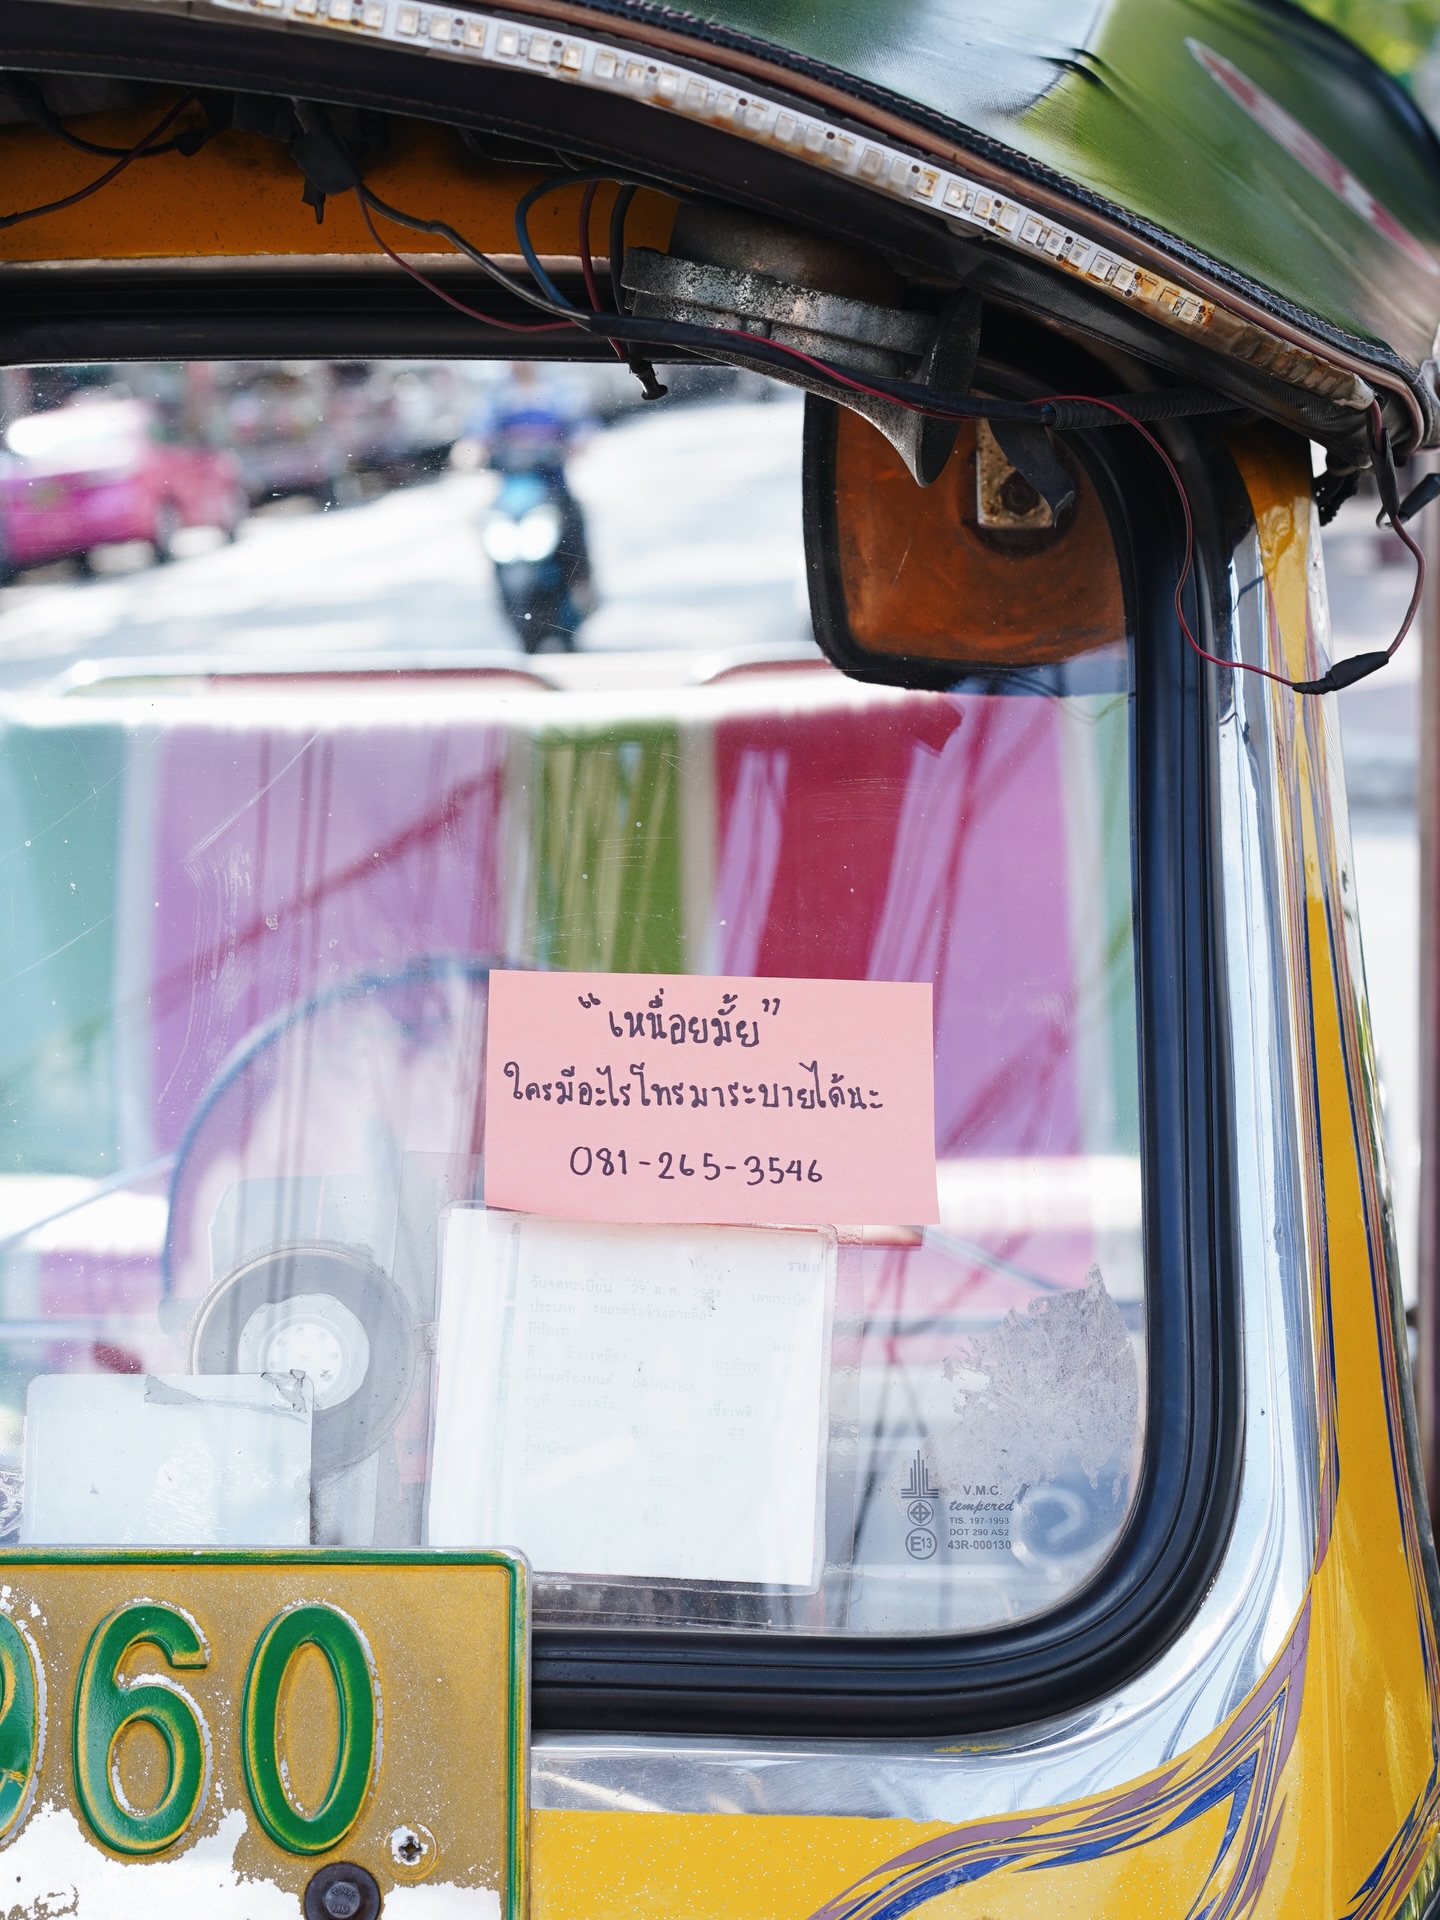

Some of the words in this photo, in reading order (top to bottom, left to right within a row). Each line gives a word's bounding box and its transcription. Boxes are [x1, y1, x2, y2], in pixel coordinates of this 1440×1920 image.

[569, 1146, 824, 1186] 081-265-3546
[631, 1283, 647, 1294] 29
[963, 1485, 1003, 1496] V.M.C.
[949, 1499, 1015, 1514] tempered
[969, 1517, 1010, 1525] 197-1993
[949, 1528, 970, 1536] DOT
[972, 1528, 988, 1536] 290
[990, 1528, 1010, 1536] AS2
[947, 1539, 1012, 1550] 43R-000130
